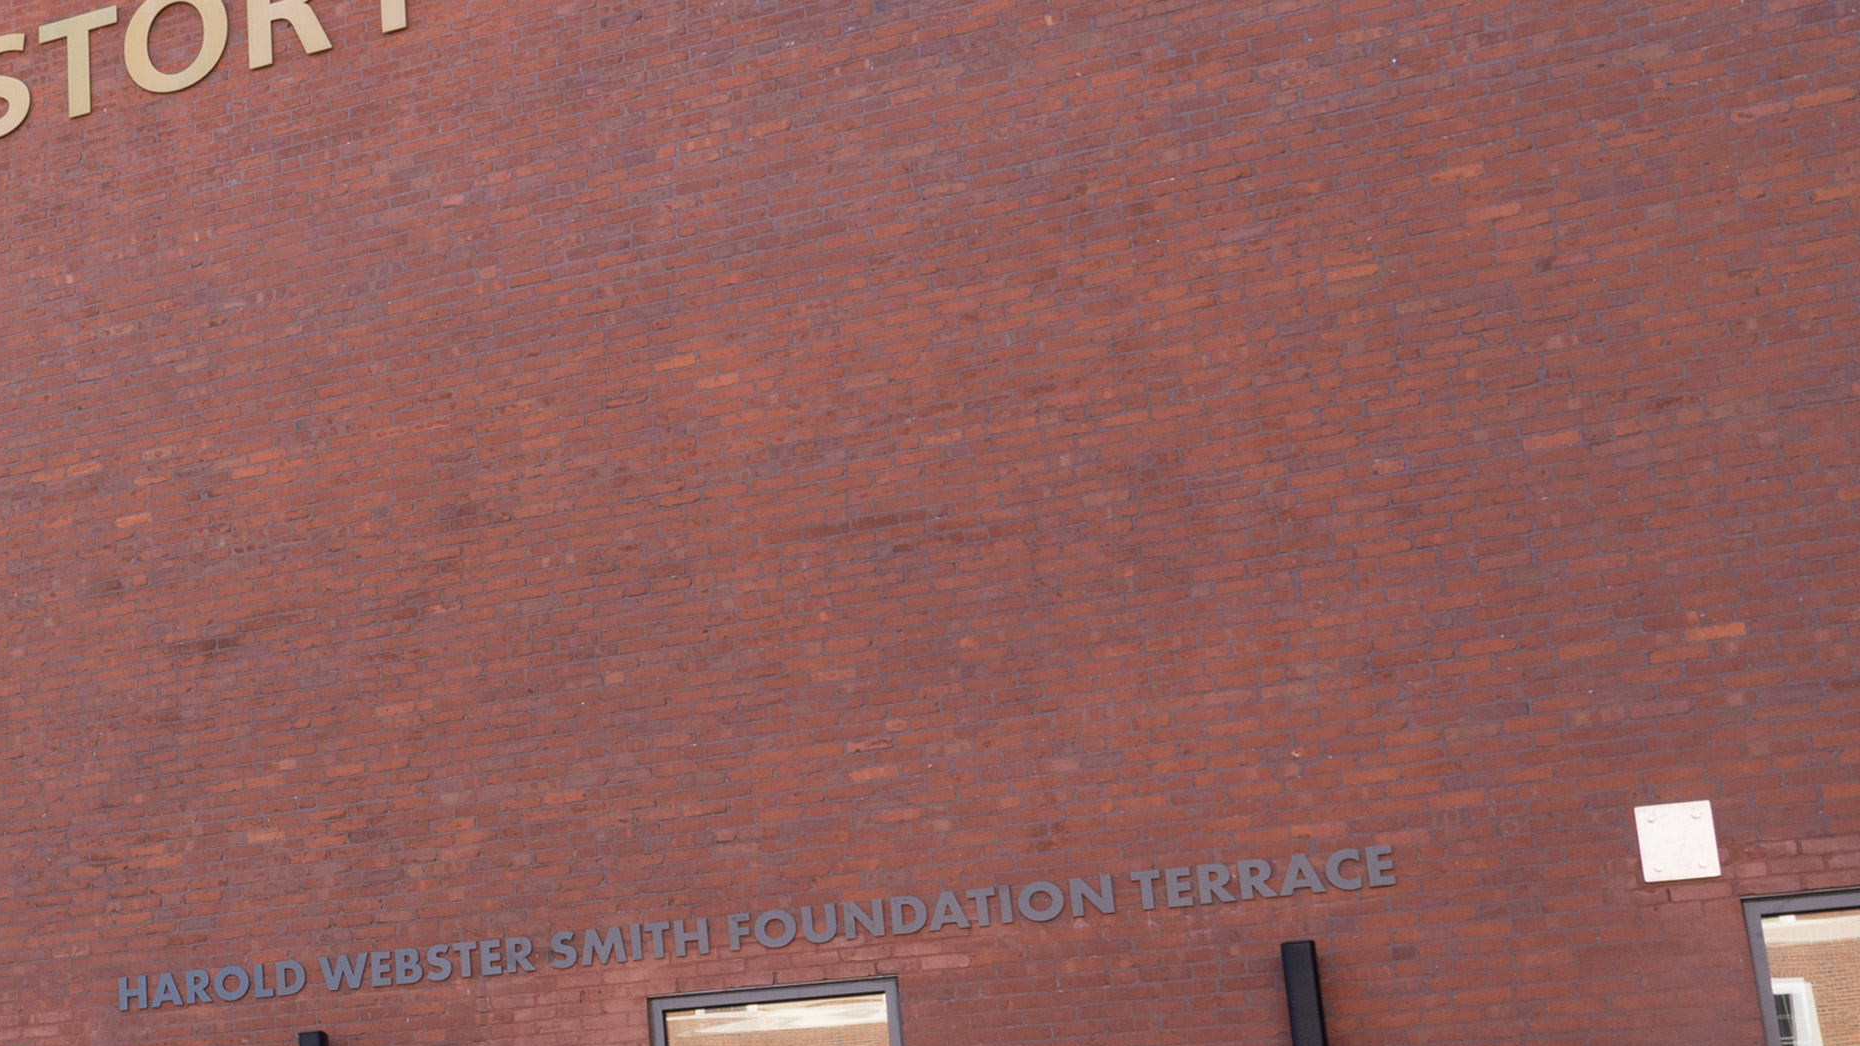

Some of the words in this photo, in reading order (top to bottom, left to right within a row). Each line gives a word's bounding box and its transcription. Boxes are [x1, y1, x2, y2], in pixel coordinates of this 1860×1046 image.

[117, 958, 307, 1012] HAROLD
[318, 935, 536, 992] WEBSTER
[550, 917, 710, 970] SMITH
[727, 873, 1116, 952] FOUNDATION
[1130, 844, 1397, 911] TERRACE
